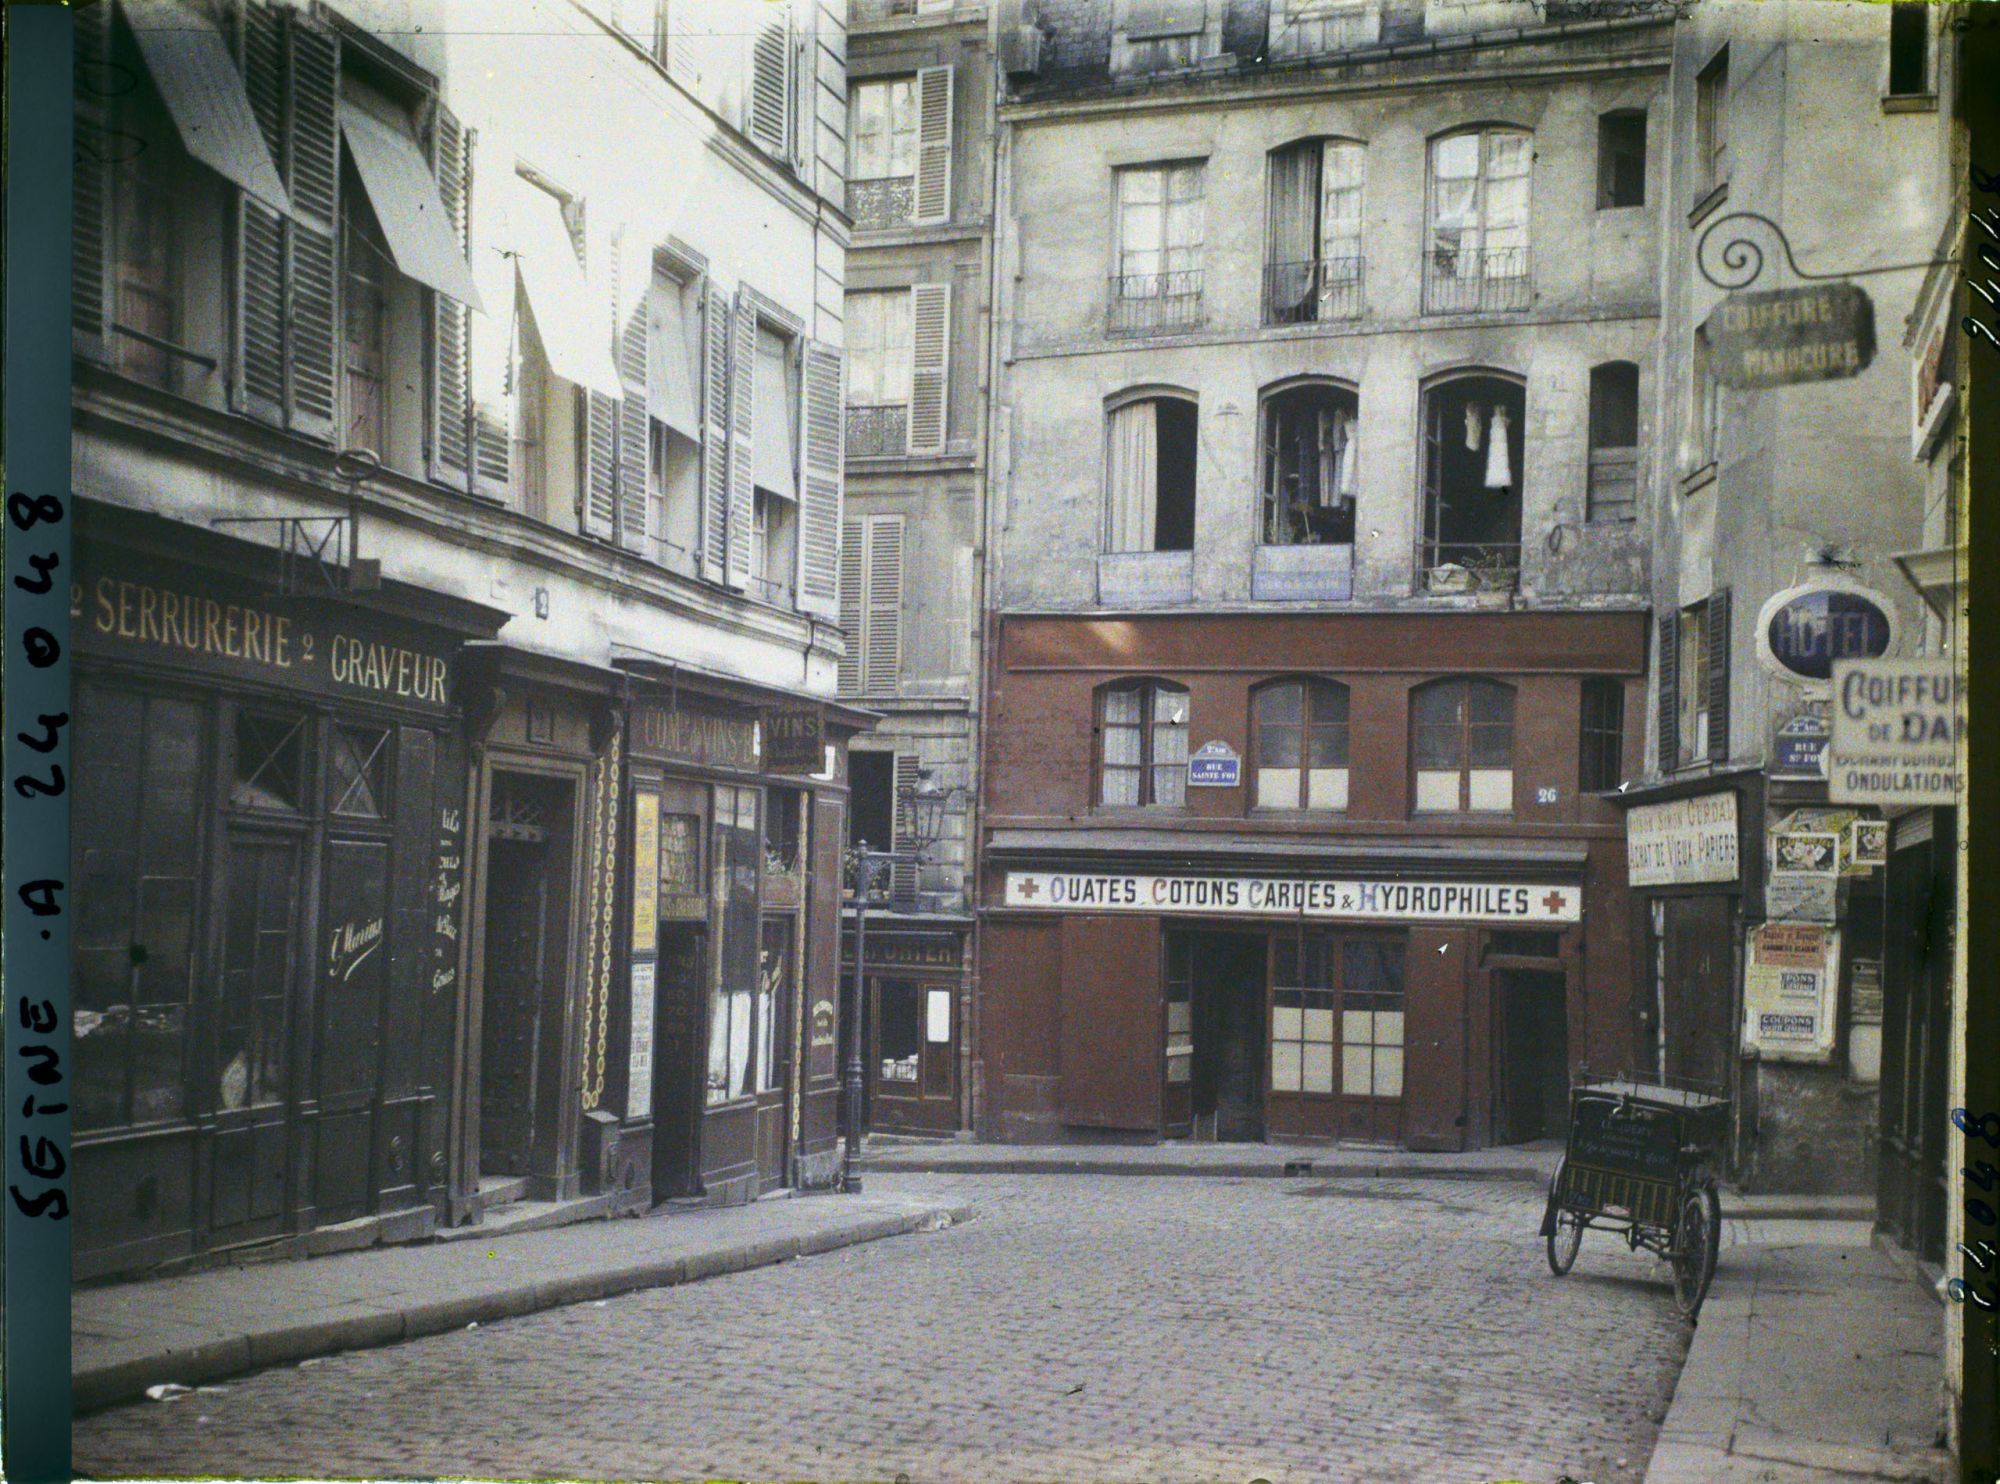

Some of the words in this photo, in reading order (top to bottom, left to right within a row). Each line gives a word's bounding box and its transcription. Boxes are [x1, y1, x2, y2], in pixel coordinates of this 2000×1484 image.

[95, 576, 292, 669] SERRURERIE
[331, 634, 447, 705] GRAVEUR
[1868, 721, 1892, 742] DE
[1794, 742, 1818, 753] RUE
[1192, 771, 1219, 780] SAINTE
[1206, 763, 1223, 771] RUE
[1846, 769, 1966, 795] ONDULATIONS
[1537, 788, 1558, 804] 26
[1666, 834, 1695, 867] VIEUX
[1697, 830, 1737, 864] PAPIERS
[1151, 877, 1239, 906] COTONS
[1249, 879, 1336, 909] CARDÉS
[1341, 893, 1353, 909] &
[1358, 882, 1529, 915] HYDROPHILES
